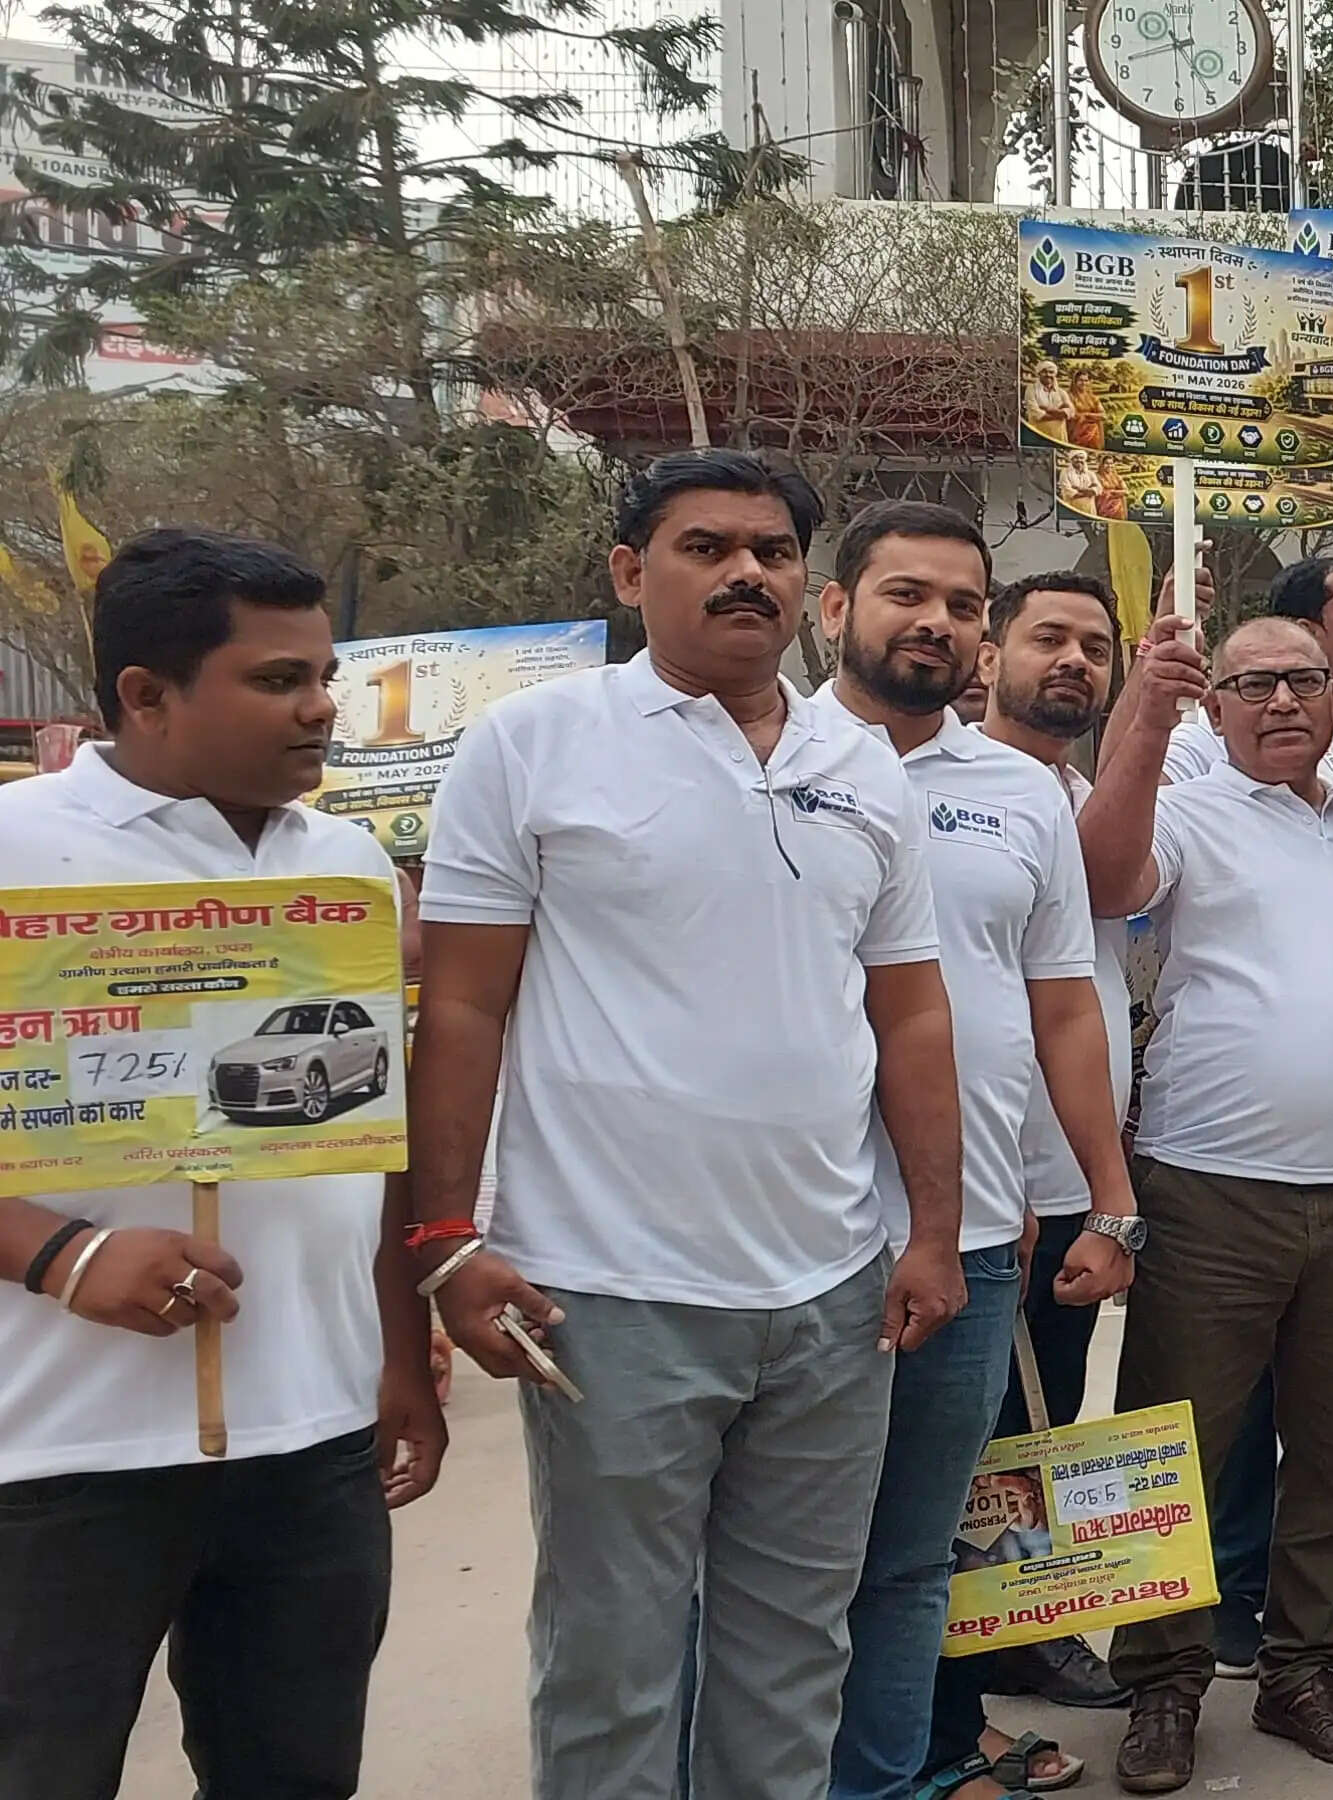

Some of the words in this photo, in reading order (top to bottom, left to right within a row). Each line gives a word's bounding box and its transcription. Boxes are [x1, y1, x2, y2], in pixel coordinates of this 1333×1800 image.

[1116, 8, 1136, 22] 10
[1228, 11, 1238, 25] 2
[1111, 35, 1121, 49] 9
[1237, 41, 1247, 55] 3
[1119, 65, 1130, 79] 8
[1228, 70, 1239, 84] 4
[1142, 88, 1153, 103] 7
[1174, 98, 1184, 112] 6
[1206, 91, 1216, 105] 5
[1075, 251, 1135, 277] BGB
[1157, 246, 1206, 261] स्थापना
[1209, 246, 1244, 268] दिवस
[1158, 350, 1229, 372] FOUNDATION
[1230, 357, 1250, 372] DAY
[1187, 374, 1214, 387] MAY
[1216, 377, 1246, 390] 2026
[341, 744, 430, 765] FOUNDATION
[432, 742, 456, 756] DAY
[956, 808, 1001, 828] BGB
[108, 898, 274, 937] ग्रामीण
[0, 1011, 54, 1049] हन
[62, 1005, 143, 1038] ऋण
[108, 1100, 147, 1122] कार
[964, 1492, 1002, 1516] LOA
[958, 1512, 1008, 1533] PERSONA
[1072, 1514, 1110, 1545] ऋण
[1110, 1503, 1193, 1538] व्यक्तिगत
[1111, 1576, 1191, 1606] बिहार
[1006, 1590, 1108, 1626] ग्रामीण
